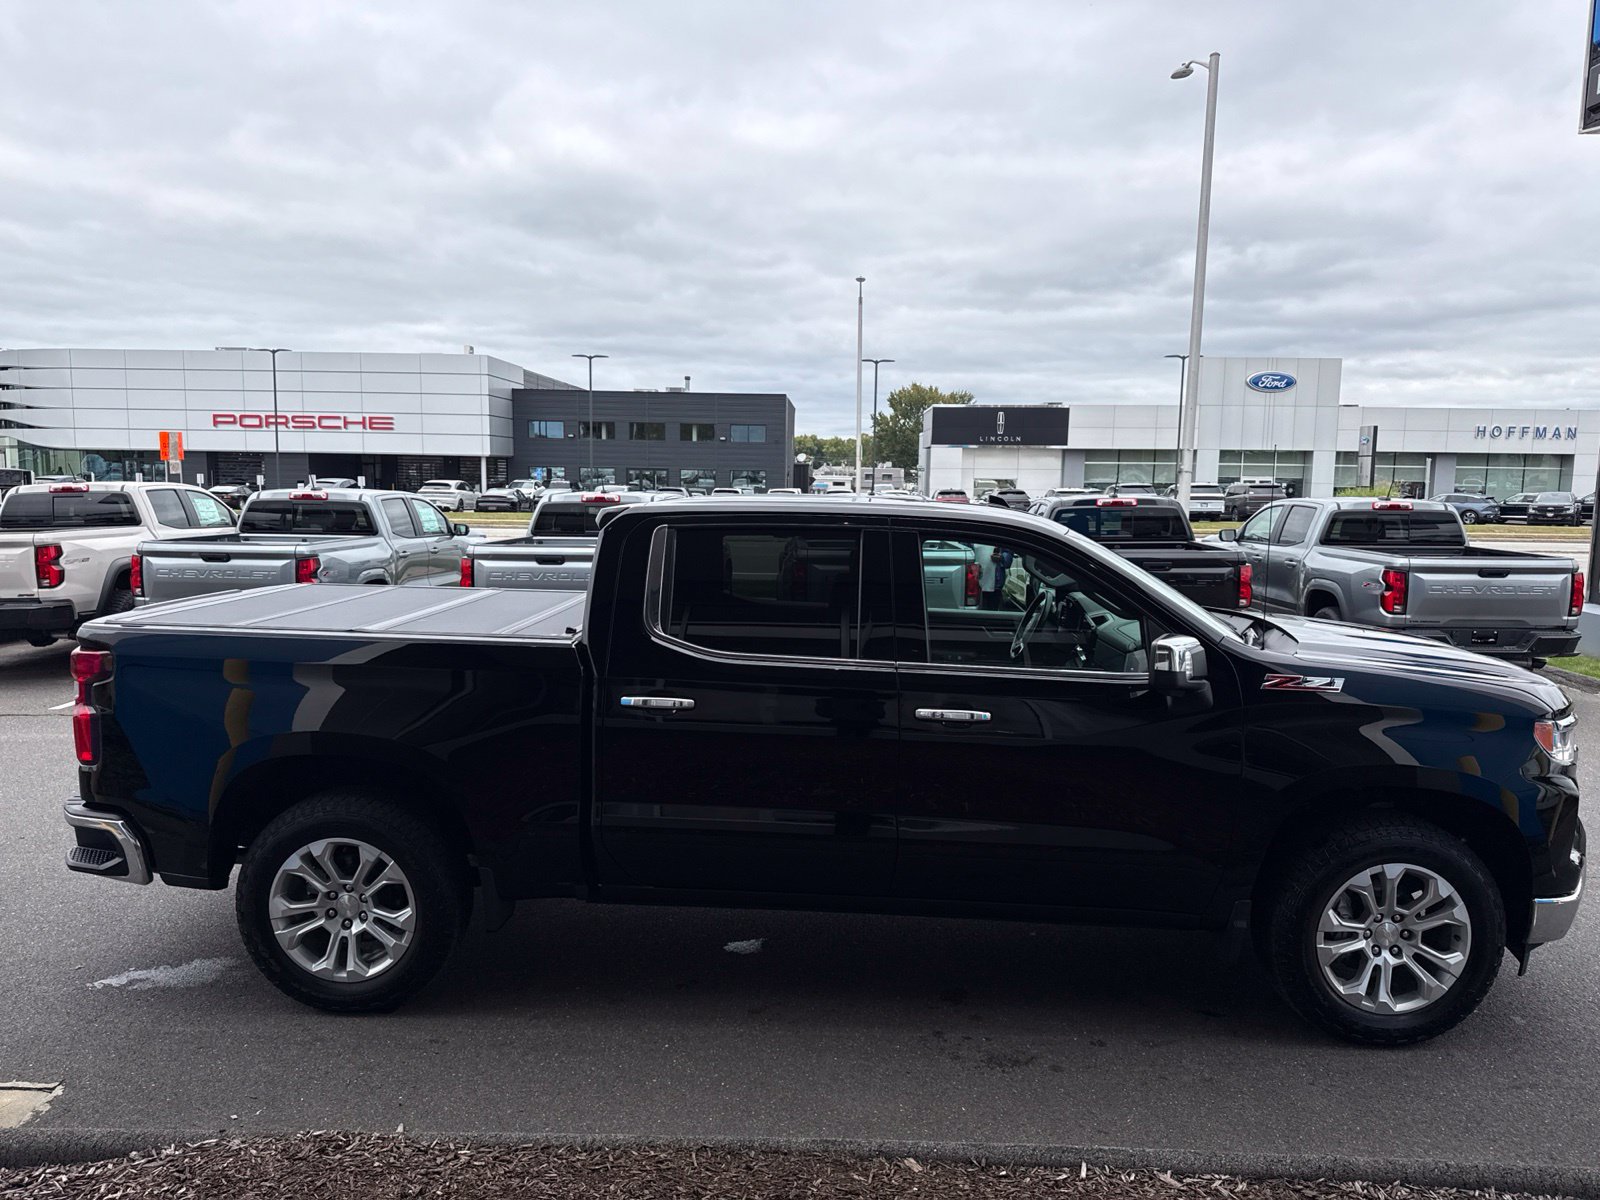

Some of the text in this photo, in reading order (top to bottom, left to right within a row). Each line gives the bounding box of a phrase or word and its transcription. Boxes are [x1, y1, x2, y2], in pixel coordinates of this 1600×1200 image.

[1258, 375, 1288, 388] Ford
[212, 413, 394, 431] PORSCHE
[1476, 425, 1577, 440] HOFFMAN
[156, 568, 277, 580] CHEVROLET
[489, 571, 590, 582] CHEVROL
[1428, 584, 1560, 595] CHEVROLET
[1260, 673, 1345, 693] Z71
